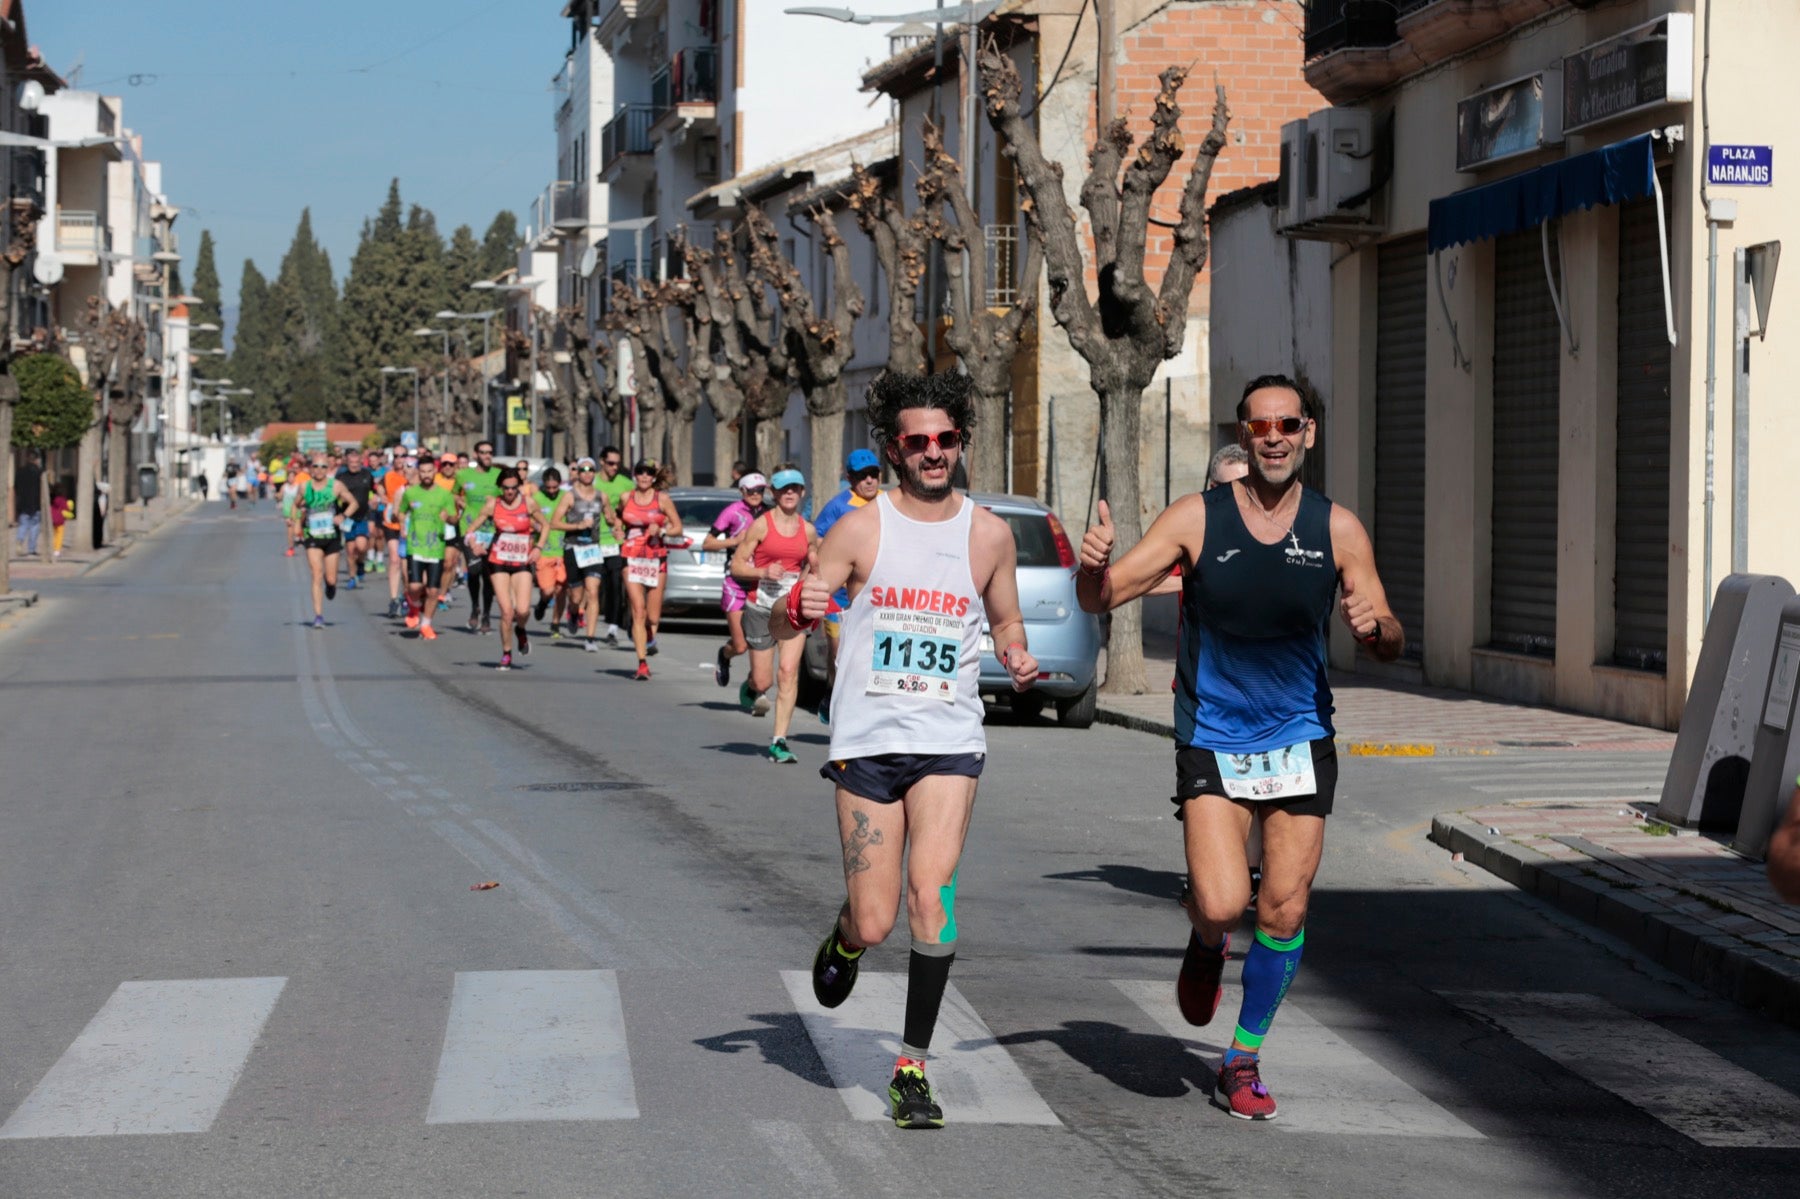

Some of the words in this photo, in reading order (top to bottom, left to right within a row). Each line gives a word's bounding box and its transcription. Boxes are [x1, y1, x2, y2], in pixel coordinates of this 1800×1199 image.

[1722, 148, 1756, 160] PLAZA
[1712, 165, 1769, 182] NARANJOS
[500, 541, 527, 553] 2089
[629, 564, 658, 579] 2092
[870, 585, 970, 618] SANDERS
[896, 614, 912, 623] GRAN
[912, 615, 934, 626] PREMIO
[934, 617, 942, 627] DE
[878, 636, 957, 674] 1135
